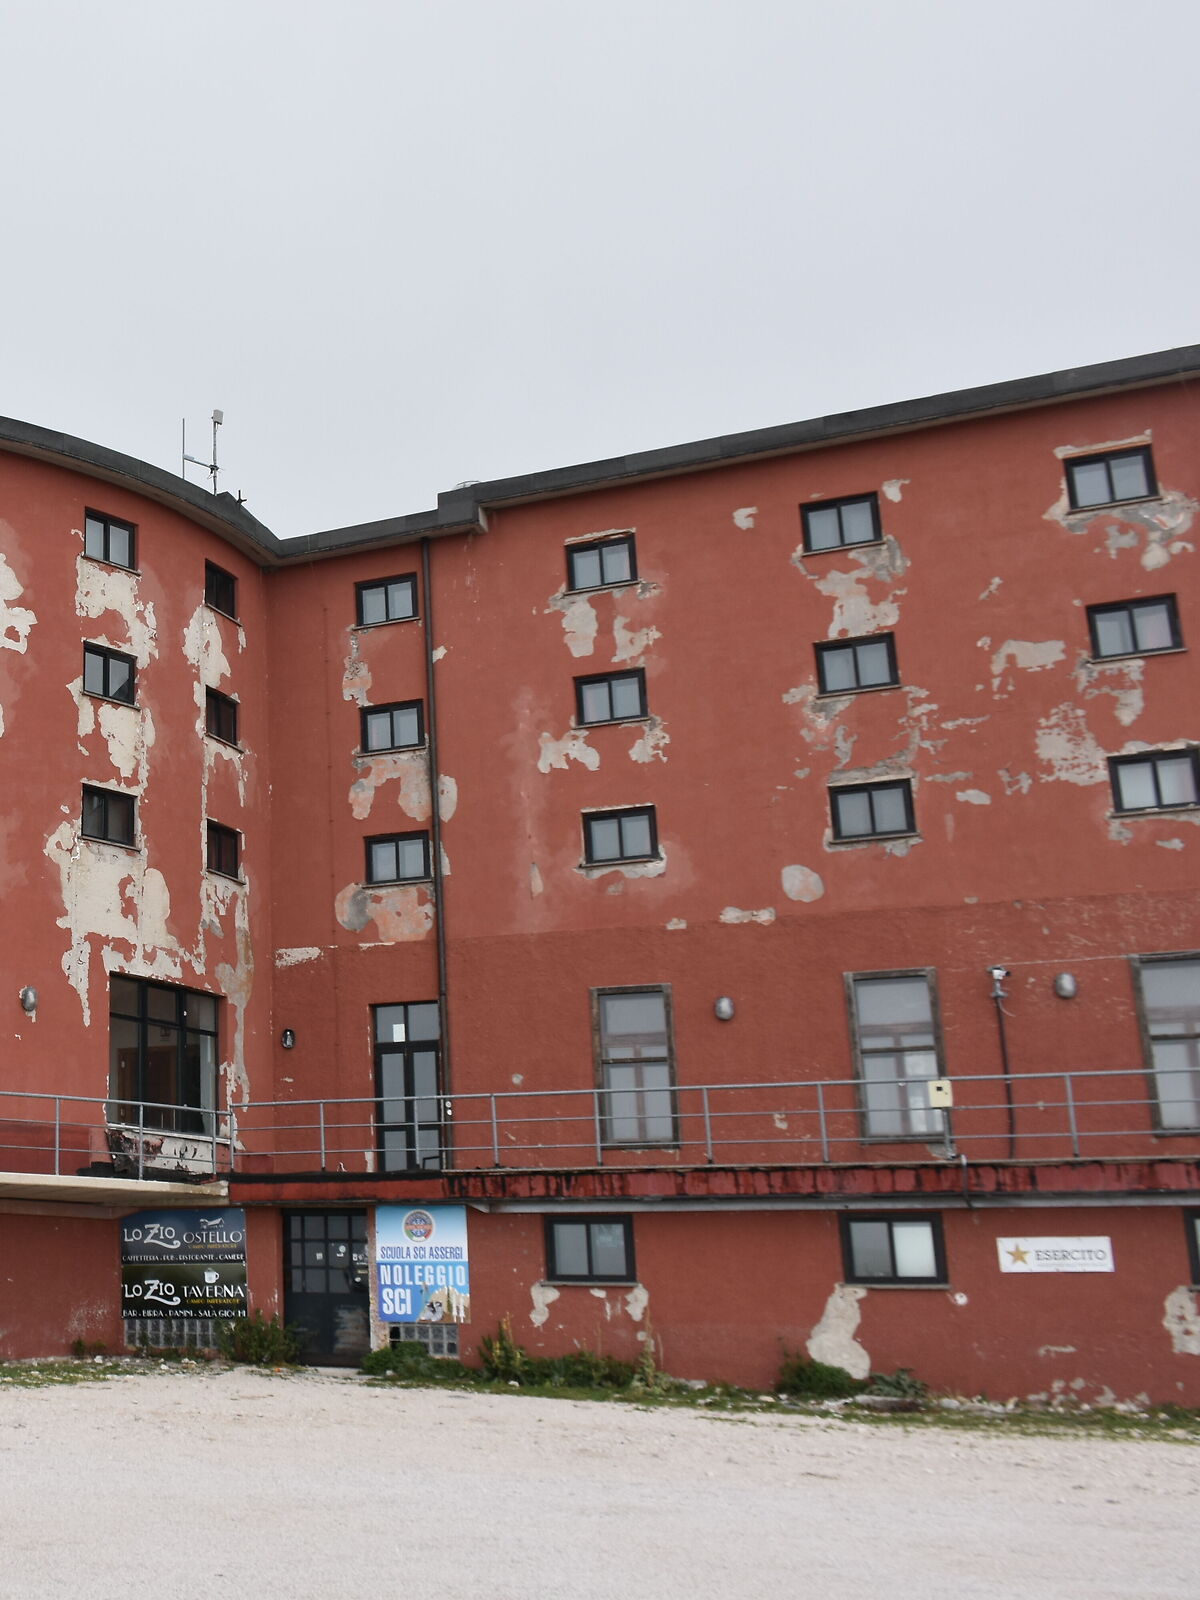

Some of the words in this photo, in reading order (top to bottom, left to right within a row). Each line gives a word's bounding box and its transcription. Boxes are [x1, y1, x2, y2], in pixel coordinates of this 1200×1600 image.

[124, 1228, 142, 1242] LO
[183, 1231, 243, 1244] OSTELLO
[218, 1253, 245, 1261] CAMERE
[380, 1246, 411, 1260] SCUOLA
[413, 1246, 427, 1260] SCI
[428, 1246, 463, 1260] ASSERGI
[1035, 1249, 1107, 1261] ESERCITO
[379, 1264, 467, 1286] NOLEGGIO
[124, 1283, 143, 1298] LO
[182, 1284, 245, 1298] TAVERNA
[382, 1287, 412, 1315] SCI
